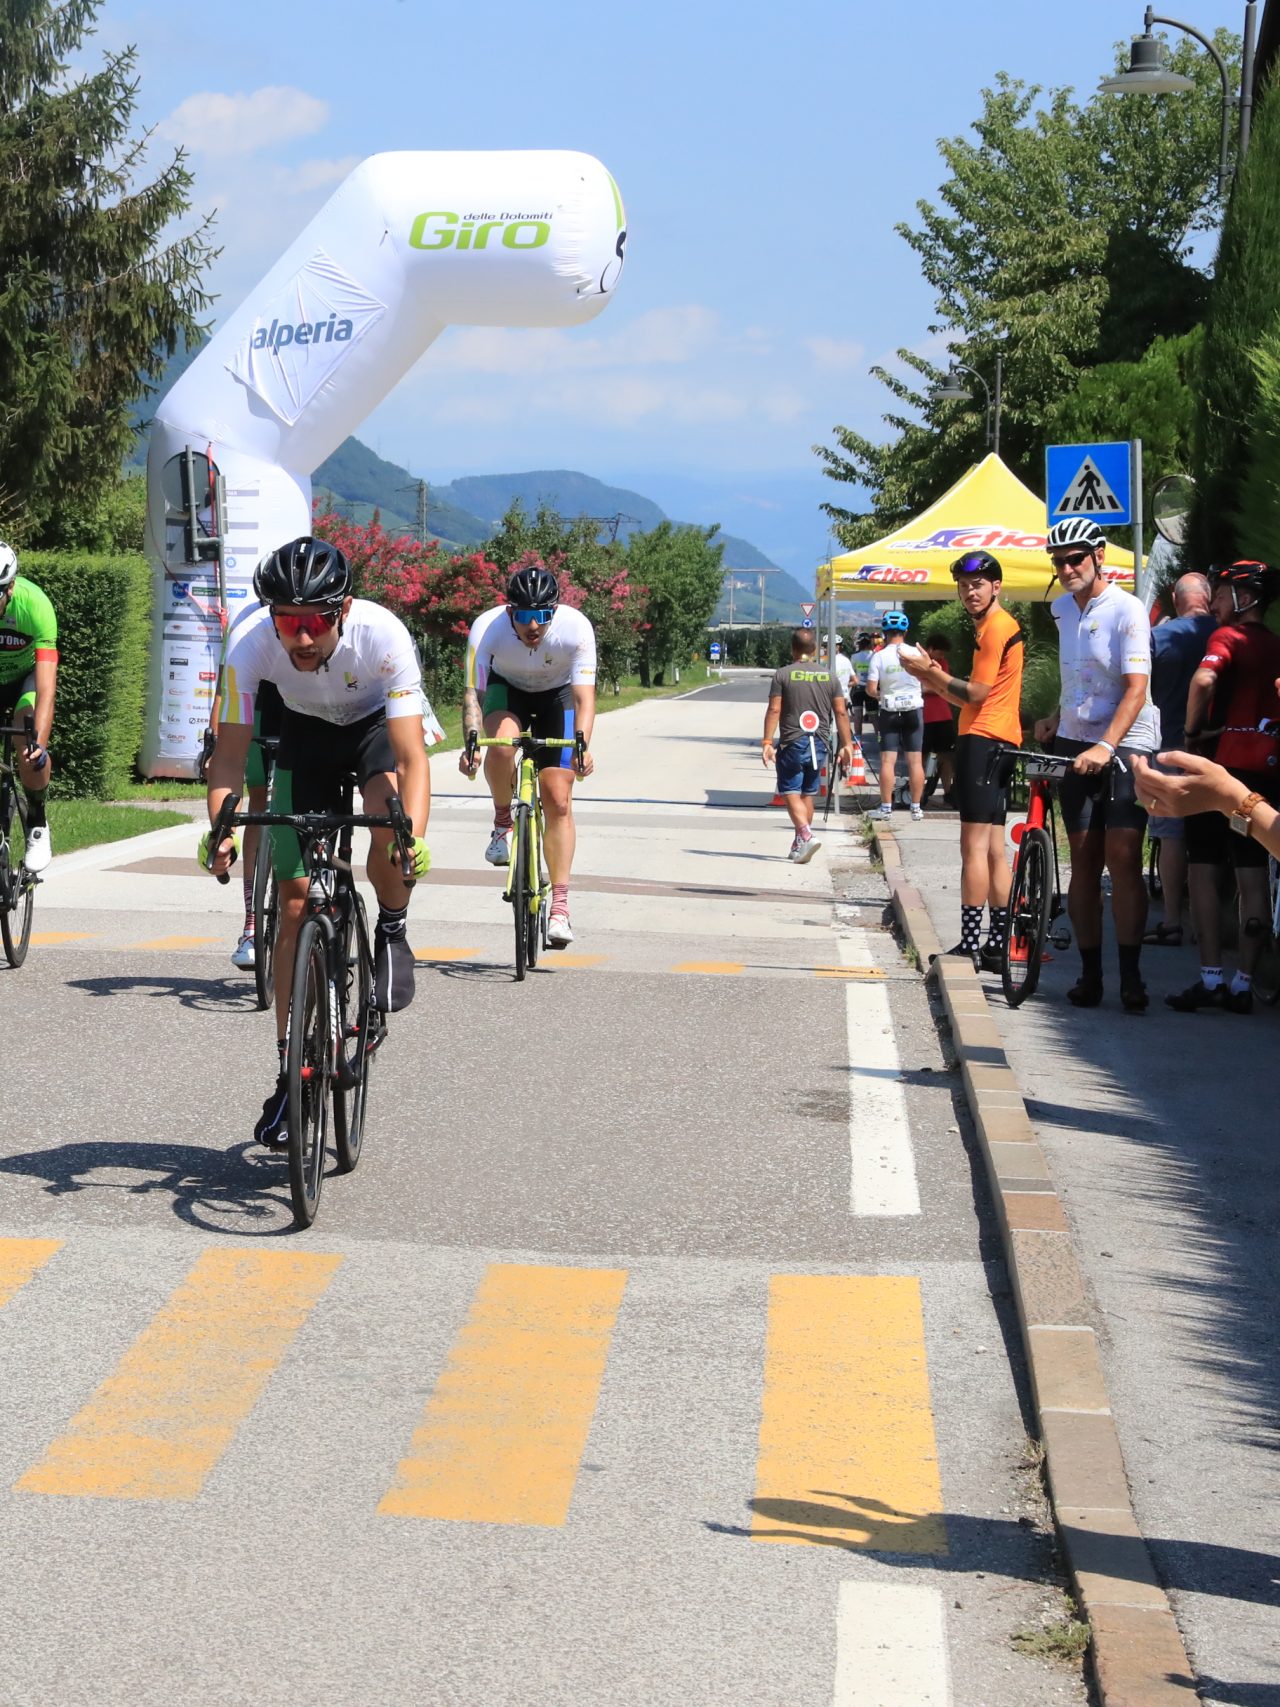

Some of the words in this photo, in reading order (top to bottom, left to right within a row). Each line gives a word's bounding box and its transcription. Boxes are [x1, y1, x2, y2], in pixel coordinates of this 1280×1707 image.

[463, 212, 496, 220] delle
[500, 211, 554, 220] Dolomiti
[408, 211, 551, 250] Giro
[252, 312, 354, 356] alperia
[790, 670, 830, 682] Giro
